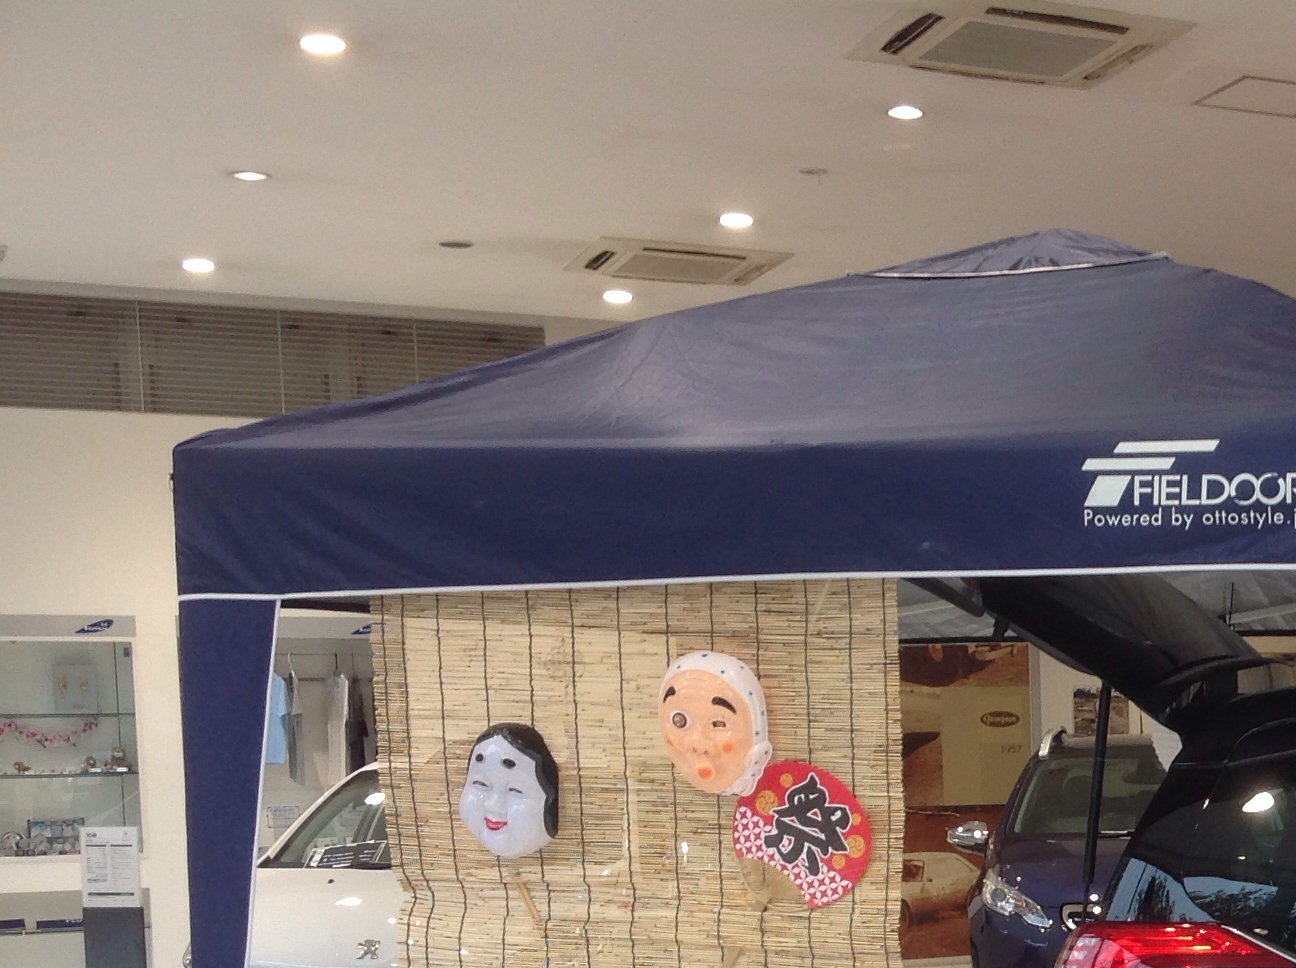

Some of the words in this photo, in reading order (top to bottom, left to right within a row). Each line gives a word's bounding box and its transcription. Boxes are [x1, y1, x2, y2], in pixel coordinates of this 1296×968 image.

[1083, 508, 1162, 527] Powered
[1171, 507, 1194, 531] by
[764, 773, 852, 877] 祭
